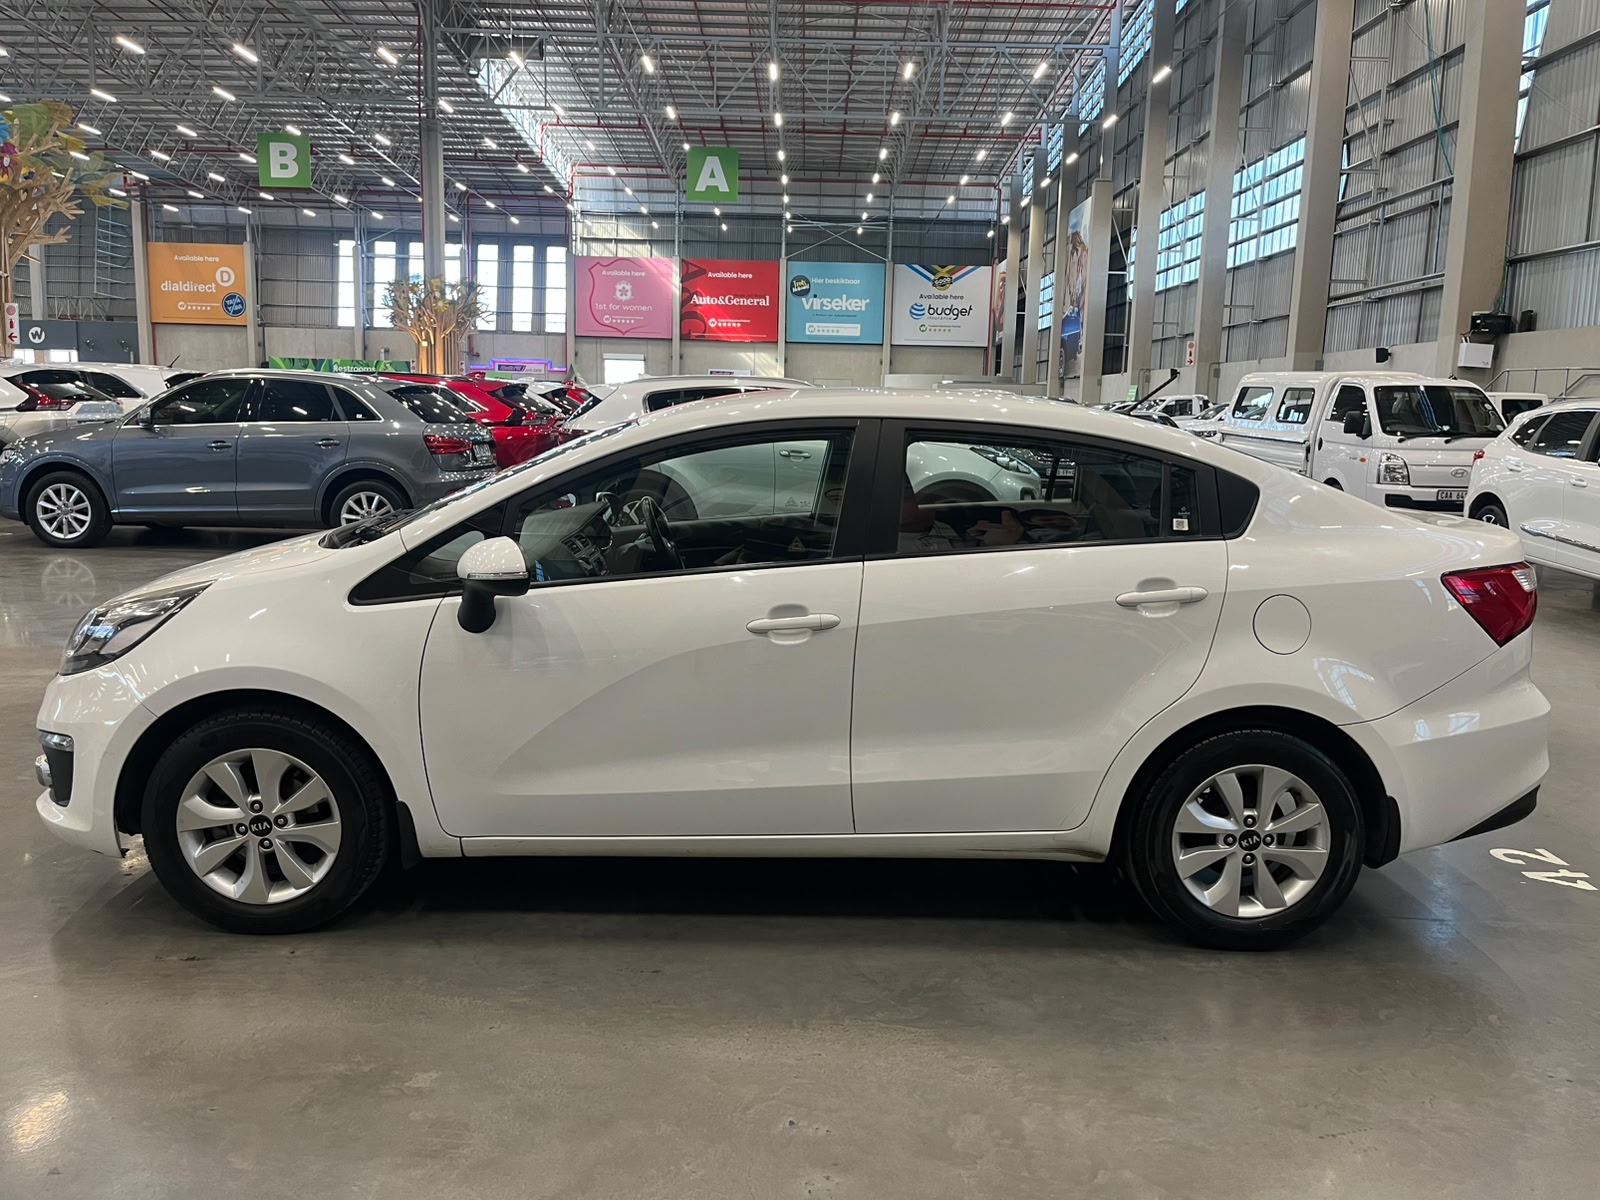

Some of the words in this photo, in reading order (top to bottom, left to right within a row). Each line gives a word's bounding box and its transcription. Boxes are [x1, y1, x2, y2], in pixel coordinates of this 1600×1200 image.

[269, 142, 299, 178] B
[694, 155, 730, 192] A
[204, 255, 220, 263] here
[601, 269, 631, 277] Available
[707, 271, 737, 279] Available
[160, 280, 216, 293] dialdirect
[825, 277, 861, 285] beskikbaar
[690, 294, 770, 306] Auto&General
[801, 293, 870, 311] virseker
[927, 303, 973, 320] budget
[29, 327, 45, 342] W
[332, 364, 377, 372] Restrooms
[250, 821, 271, 832] KIA
[1240, 835, 1260, 848] KIA
[1489, 848, 1599, 891] 42
